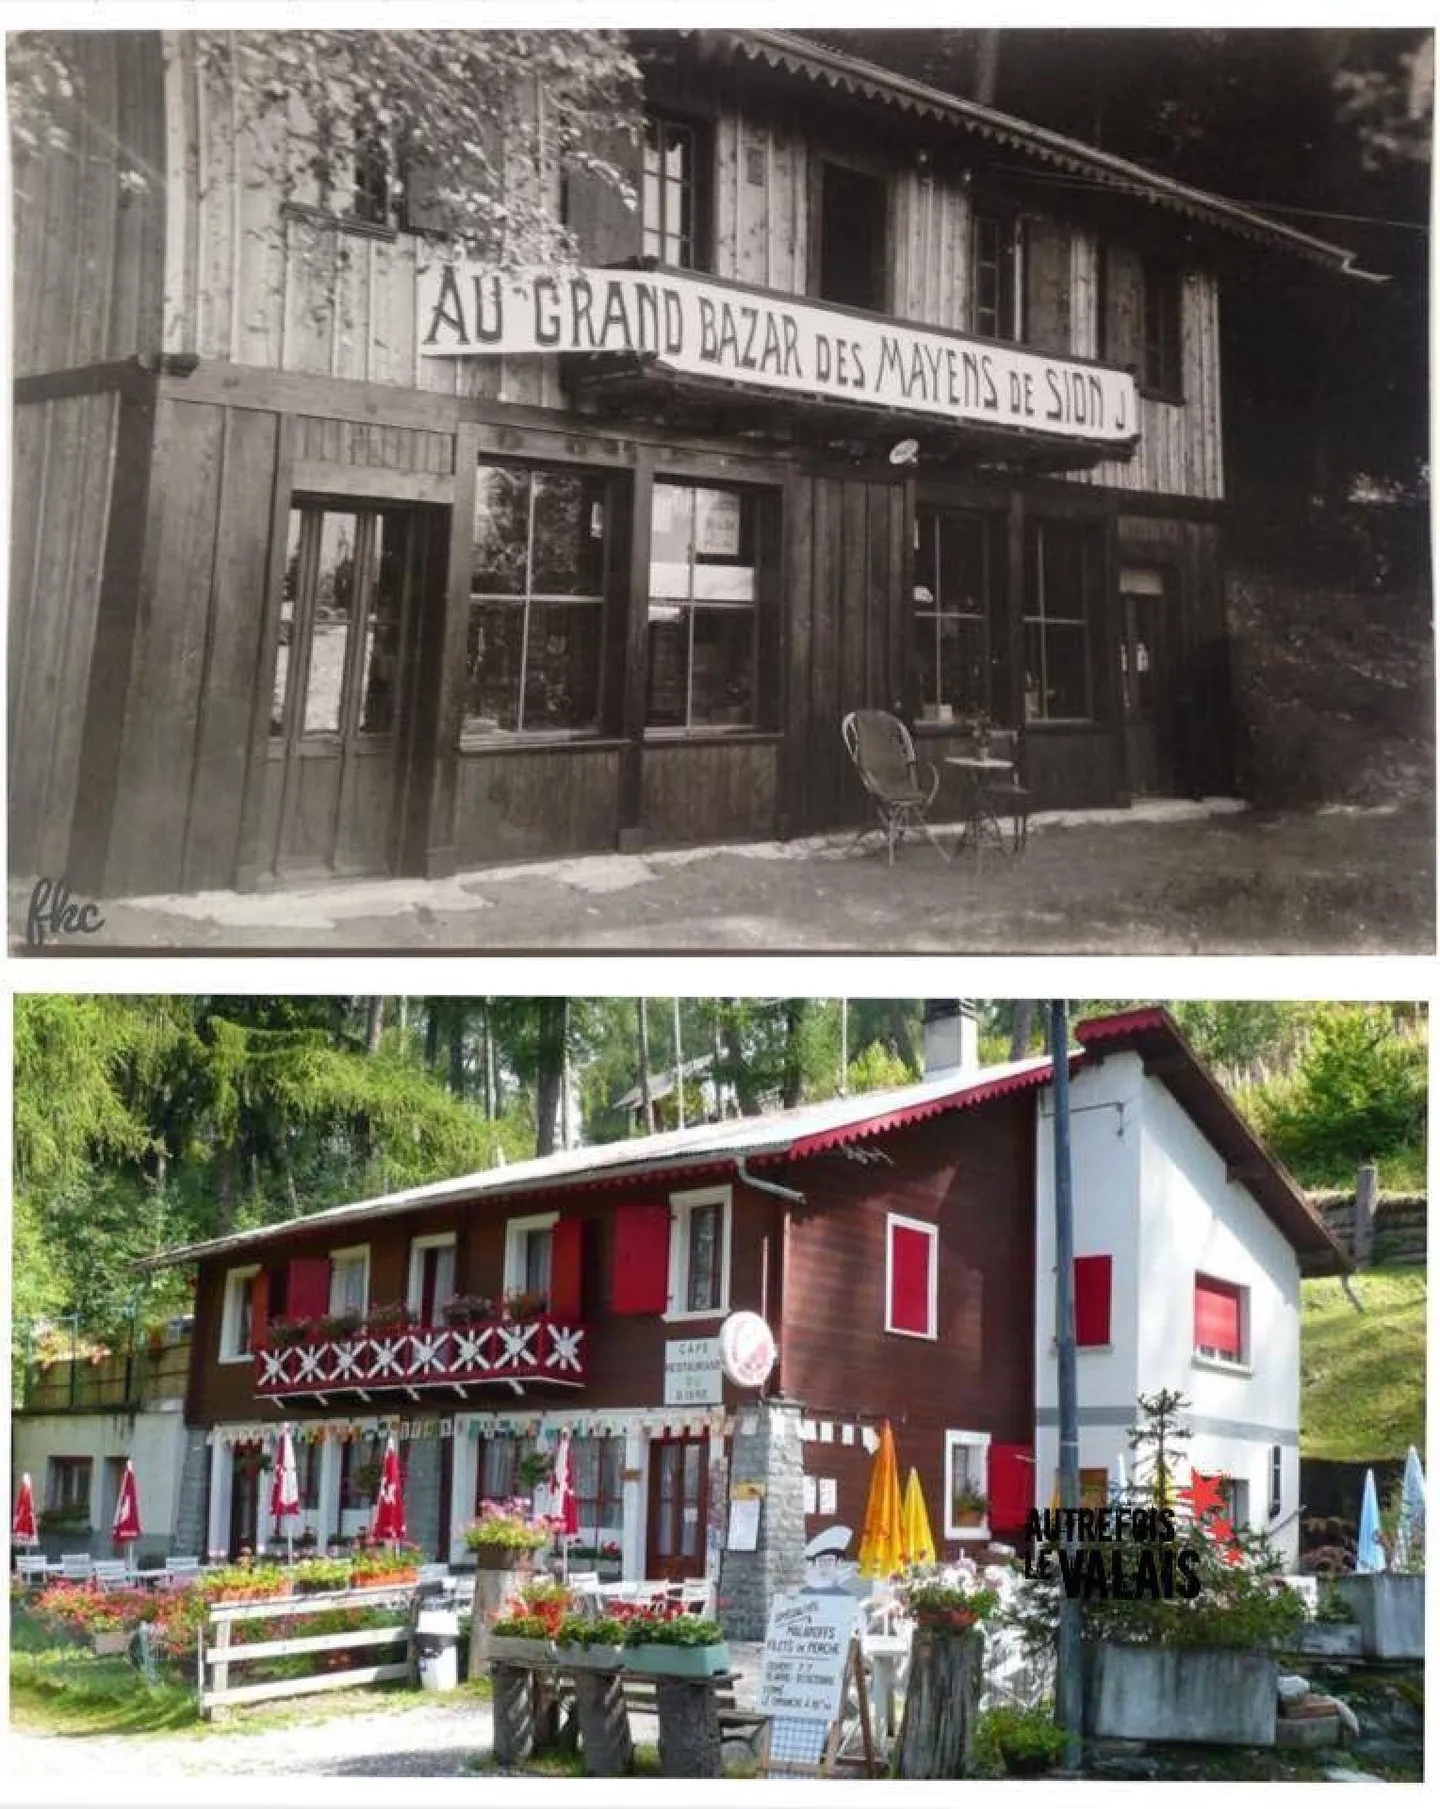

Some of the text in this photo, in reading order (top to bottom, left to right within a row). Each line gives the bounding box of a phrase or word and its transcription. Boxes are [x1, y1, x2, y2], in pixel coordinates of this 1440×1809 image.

[422, 264, 503, 345] AU
[534, 276, 683, 353] GRAND
[699, 295, 804, 379] BAZAR
[815, 333, 866, 390] DES
[874, 334, 998, 410] MAYENS
[1009, 370, 1035, 417] DE
[1045, 368, 1104, 429] SION
